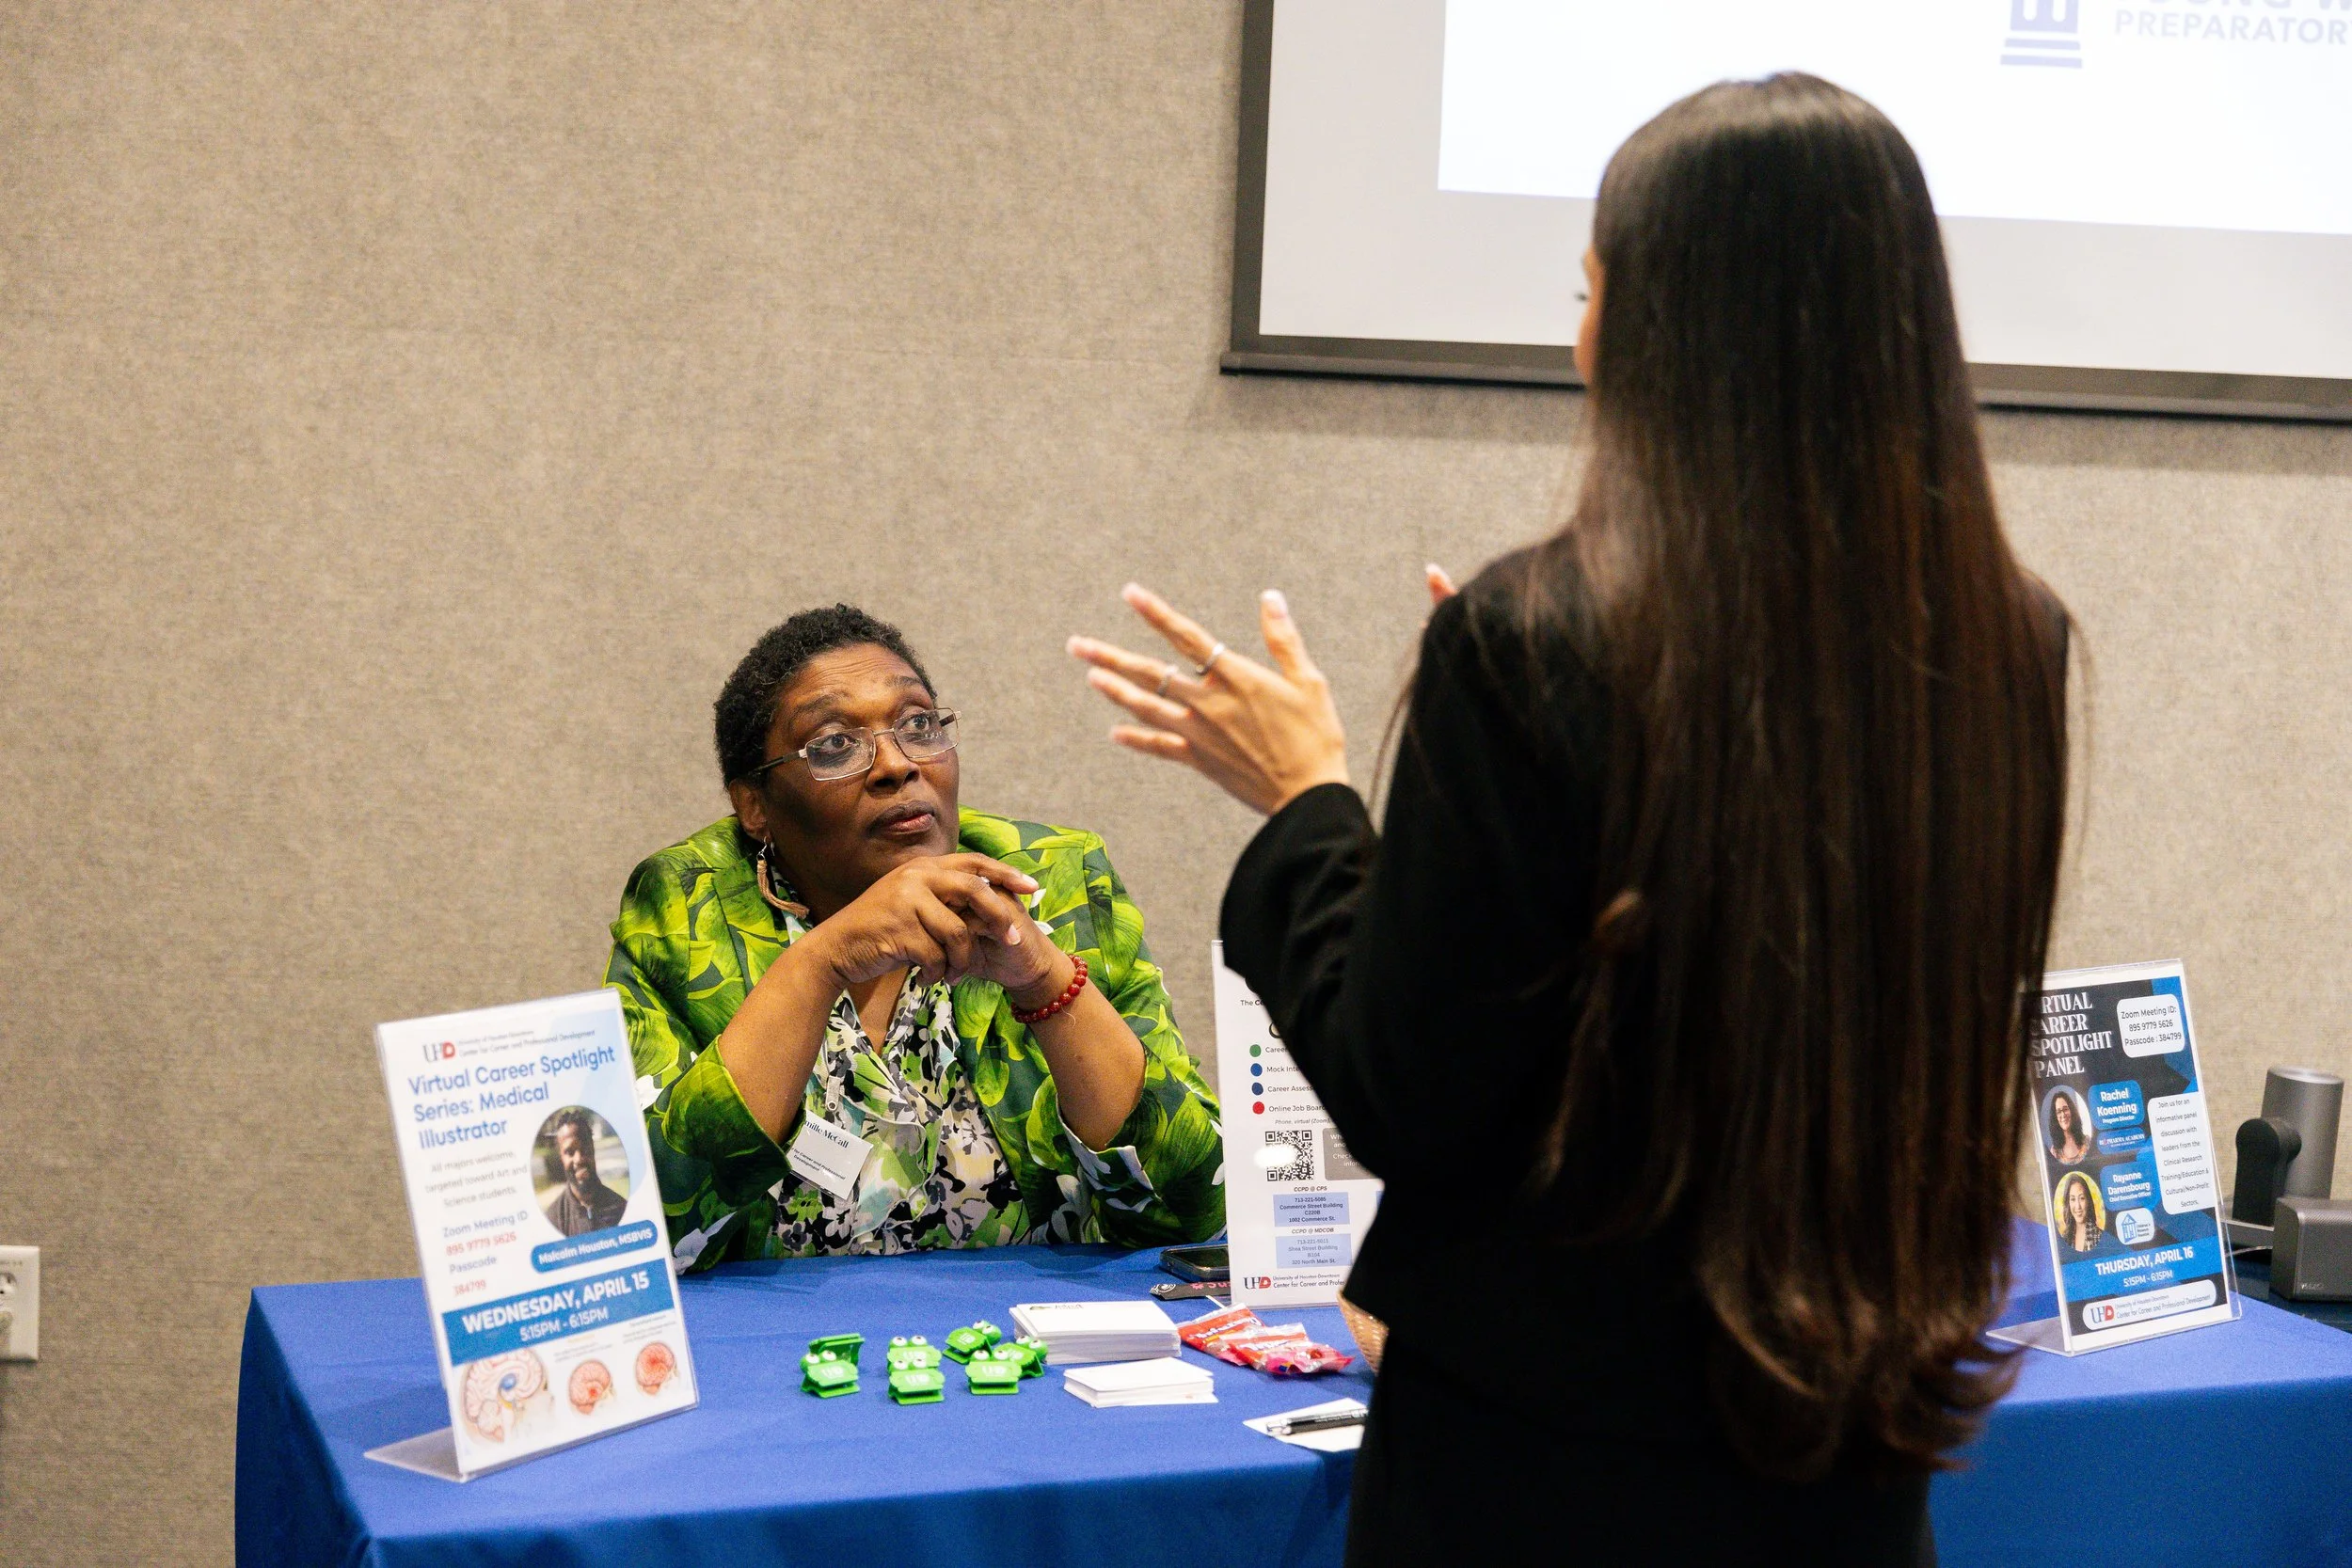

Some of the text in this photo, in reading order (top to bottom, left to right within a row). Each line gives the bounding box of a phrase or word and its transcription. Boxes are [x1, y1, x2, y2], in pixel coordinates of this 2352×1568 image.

[2114, 8, 2352, 45] PREPARATOR
[2041, 992, 2092, 1013] RTUAL
[2121, 1006, 2177, 1020] Zoom Meeting ID:
[2041, 1013, 2089, 1035] AREER
[2129, 1019, 2173, 1032] 895 9779 5626
[2124, 1036, 2154, 1046] Passcode
[2158, 1032, 2182, 1042] 384799
[422, 1040, 456, 1063] UHD
[407, 1045, 615, 1096] Virtual Career Spotlight
[2033, 1055, 2085, 1079] PANEL
[414, 1082, 549, 1122] Series: Medical
[2100, 1087, 2129, 1102] Rachel
[2097, 1101, 2137, 1117] Koenning
[419, 1118, 507, 1149] Illustrator
[823, 1130, 850, 1148] McCall
[443, 1211, 528, 1238] Zoom Meeting ID
[538, 1247, 578, 1265] Malcolm
[579, 1239, 618, 1256] Houston,
[2094, 1246, 2194, 1275] THURSDAY, APRIL 16
[449, 1255, 497, 1274] Passcode
[1243, 1276, 1272, 1290] UHD
[2123, 1275, 2146, 1287] 5:15PM
[2151, 1270, 2173, 1281] 6:15PM
[462, 1271, 650, 1334] WEDNESDAY, APRIL 15
[519, 1319, 561, 1342] 5:15PM
[569, 1307, 610, 1328] 6:15PM
[2090, 1305, 2115, 1323] UHD
